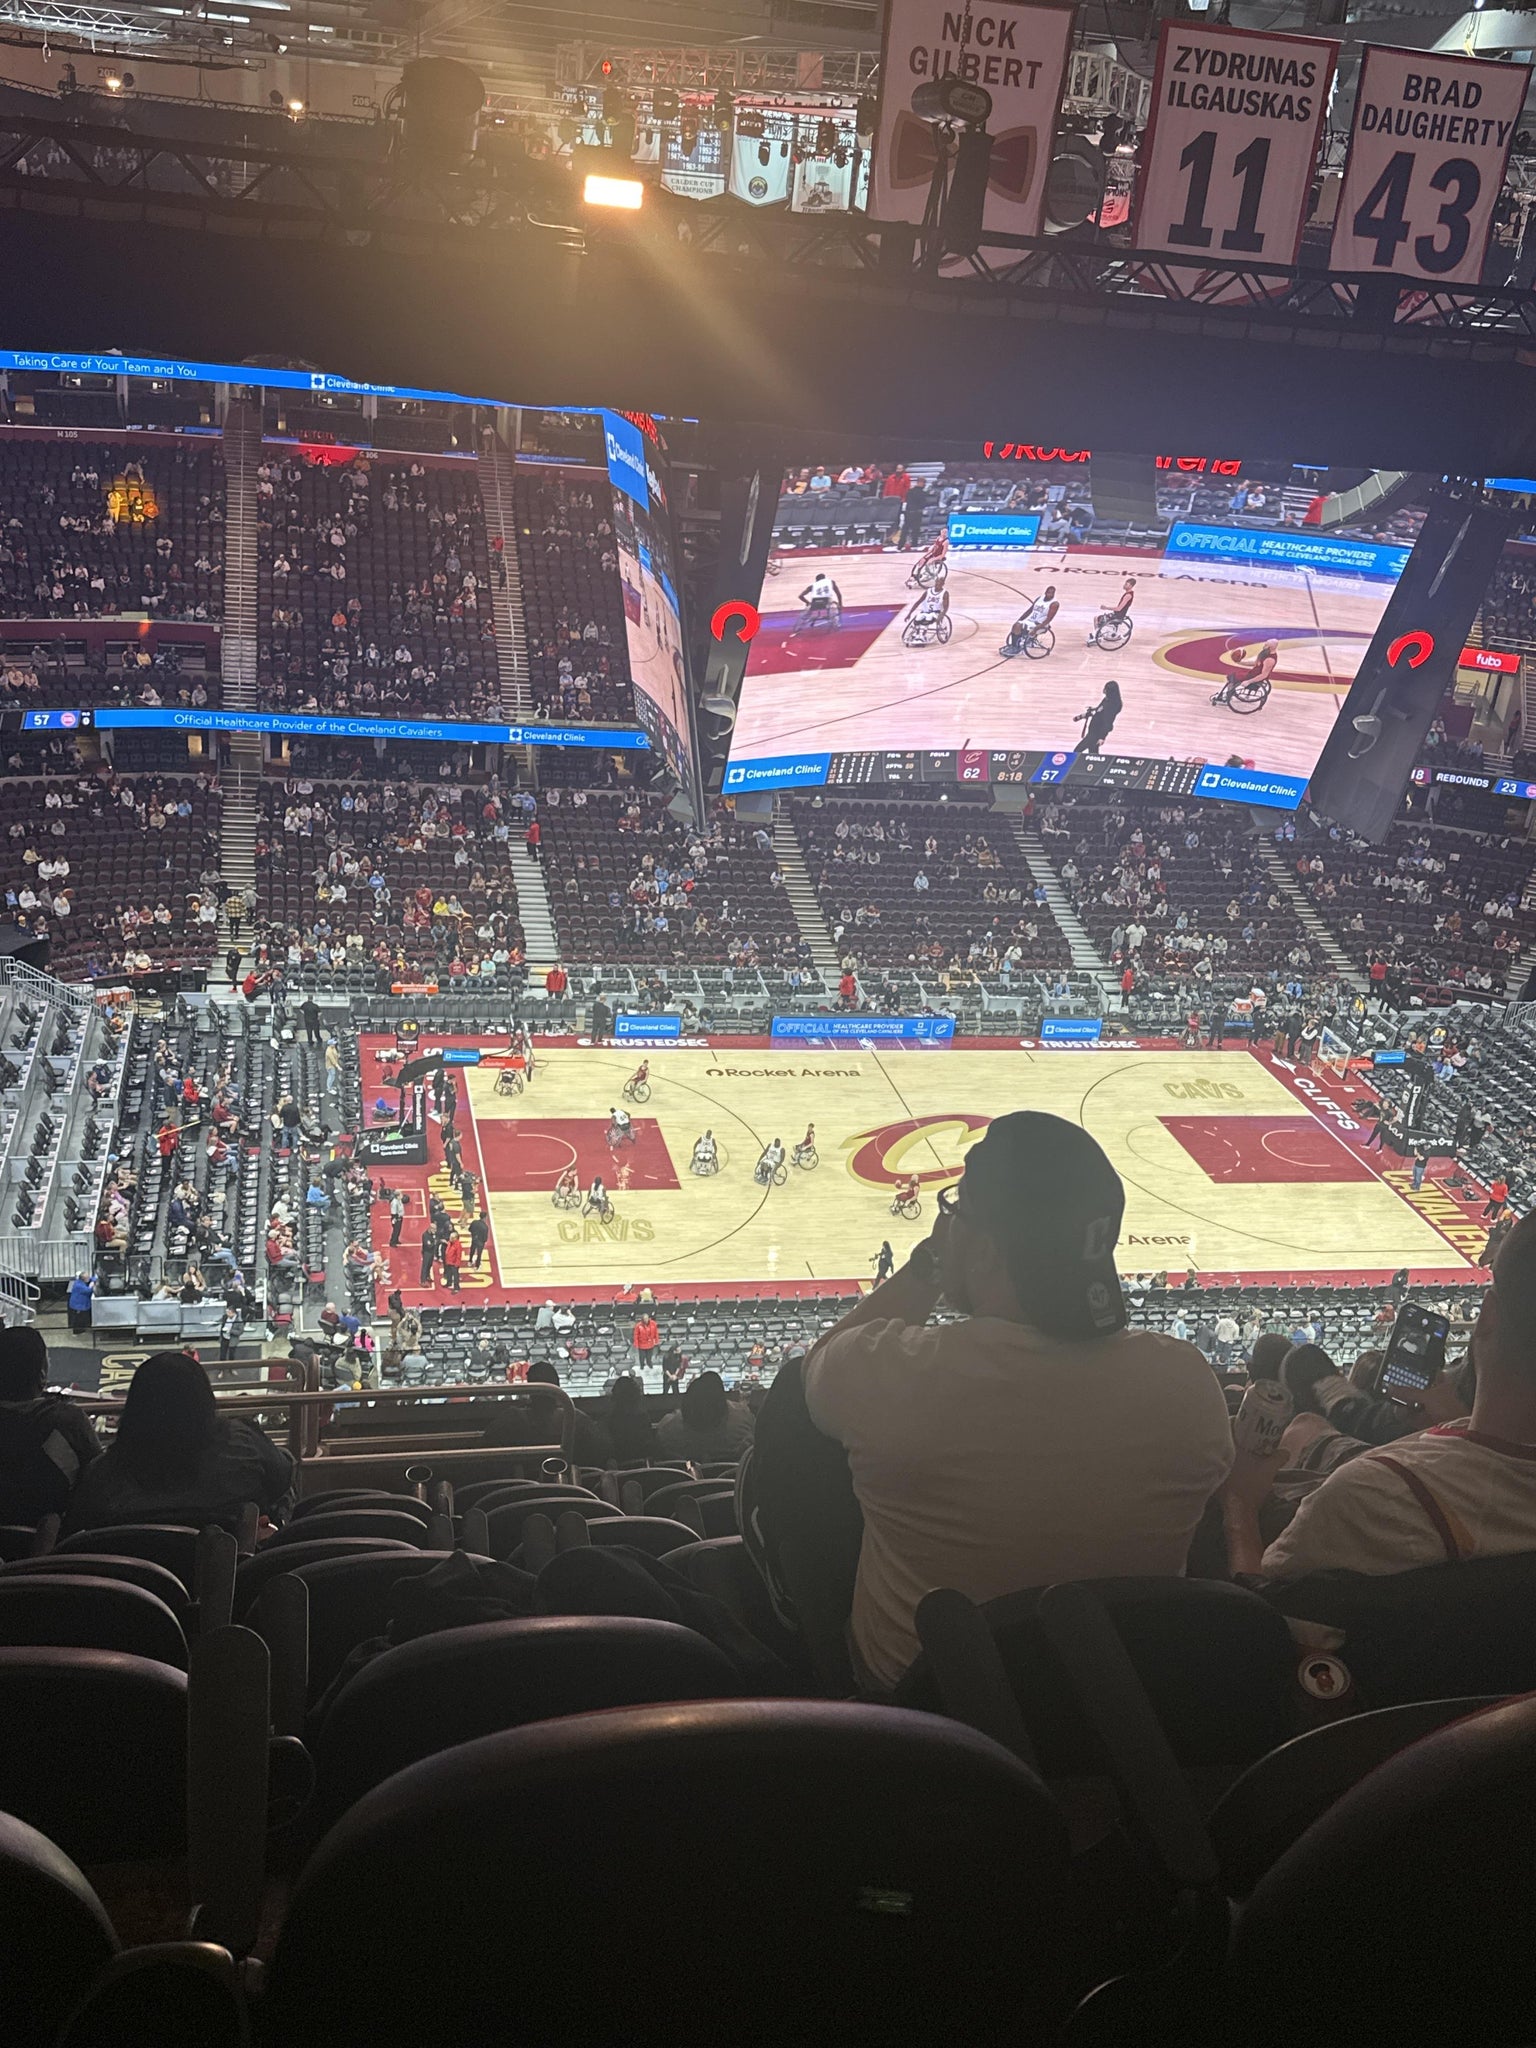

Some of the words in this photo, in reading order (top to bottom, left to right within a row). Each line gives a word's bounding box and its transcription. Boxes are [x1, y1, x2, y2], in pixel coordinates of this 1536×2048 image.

[942, 12, 1017, 50] NICK
[909, 46, 1042, 89] GILBERT
[1173, 45, 1316, 88] ZYDRUNAS
[1168, 80, 1312, 122] ILGAUSKAS
[1403, 74, 1482, 109] BRAD
[1361, 104, 1512, 147] DAUGHERTY
[672, 186, 713, 194] CHAMPIONS
[1168, 130, 1272, 254] 11
[1352, 150, 1484, 275] 43
[13, 355, 48, 368] Taking
[51, 357, 77, 369] Care
[81, 358, 92, 370] of
[95, 358, 119, 372] Your
[123, 361, 150, 373] Team
[154, 363, 174, 374] and
[177, 365, 196, 377] You
[966, 527, 1008, 536] Cleveland
[1008, 528, 1032, 536] Clinic
[1176, 532, 1257, 553] OFFICIAL
[1261, 540, 1325, 554] HEALTHCARE
[1326, 546, 1376, 561] PROVIDER
[1287, 551, 1330, 562] CLEVELAND
[1332, 556, 1373, 567] CAVALIERS
[1064, 567, 1168, 579] Rocket
[1175, 574, 1268, 588] Arena
[1476, 654, 1502, 667] fubo
[34, 714, 50, 726] 57
[174, 713, 212, 725] Official
[215, 716, 269, 729] Healthcare
[273, 718, 314, 731] Provider
[316, 721, 326, 732] of
[329, 722, 346, 733] the
[348, 723, 396, 735] Cleveland
[399, 725, 442, 738] Cavaliers
[524, 732, 562, 741] Cleveland
[563, 733, 586, 742] Clinic
[746, 766, 794, 780] Cleveland
[795, 764, 822, 776] Clinic
[963, 768, 980, 779] 62
[997, 772, 1023, 781] 8:18
[1041, 770, 1059, 780] 57
[1436, 773, 1489, 789] REBOUNDS
[1220, 778, 1268, 794] Cleveland
[1269, 784, 1297, 797] Clinic
[1501, 782, 1517, 794] 23
[777, 1023, 832, 1034] OFFICIAL
[601, 1038, 709, 1047] TRUSTEDSEC
[725, 1068, 796, 1078] Rocket
[801, 1068, 860, 1078] Arena
[1163, 1079, 1246, 1100] CAVS
[1294, 1078, 1360, 1131] CLIFFS
[1382, 1170, 1490, 1265] CAVALIER
[557, 1214, 655, 1243] CAVS
[1128, 1234, 1192, 1246] Arena
